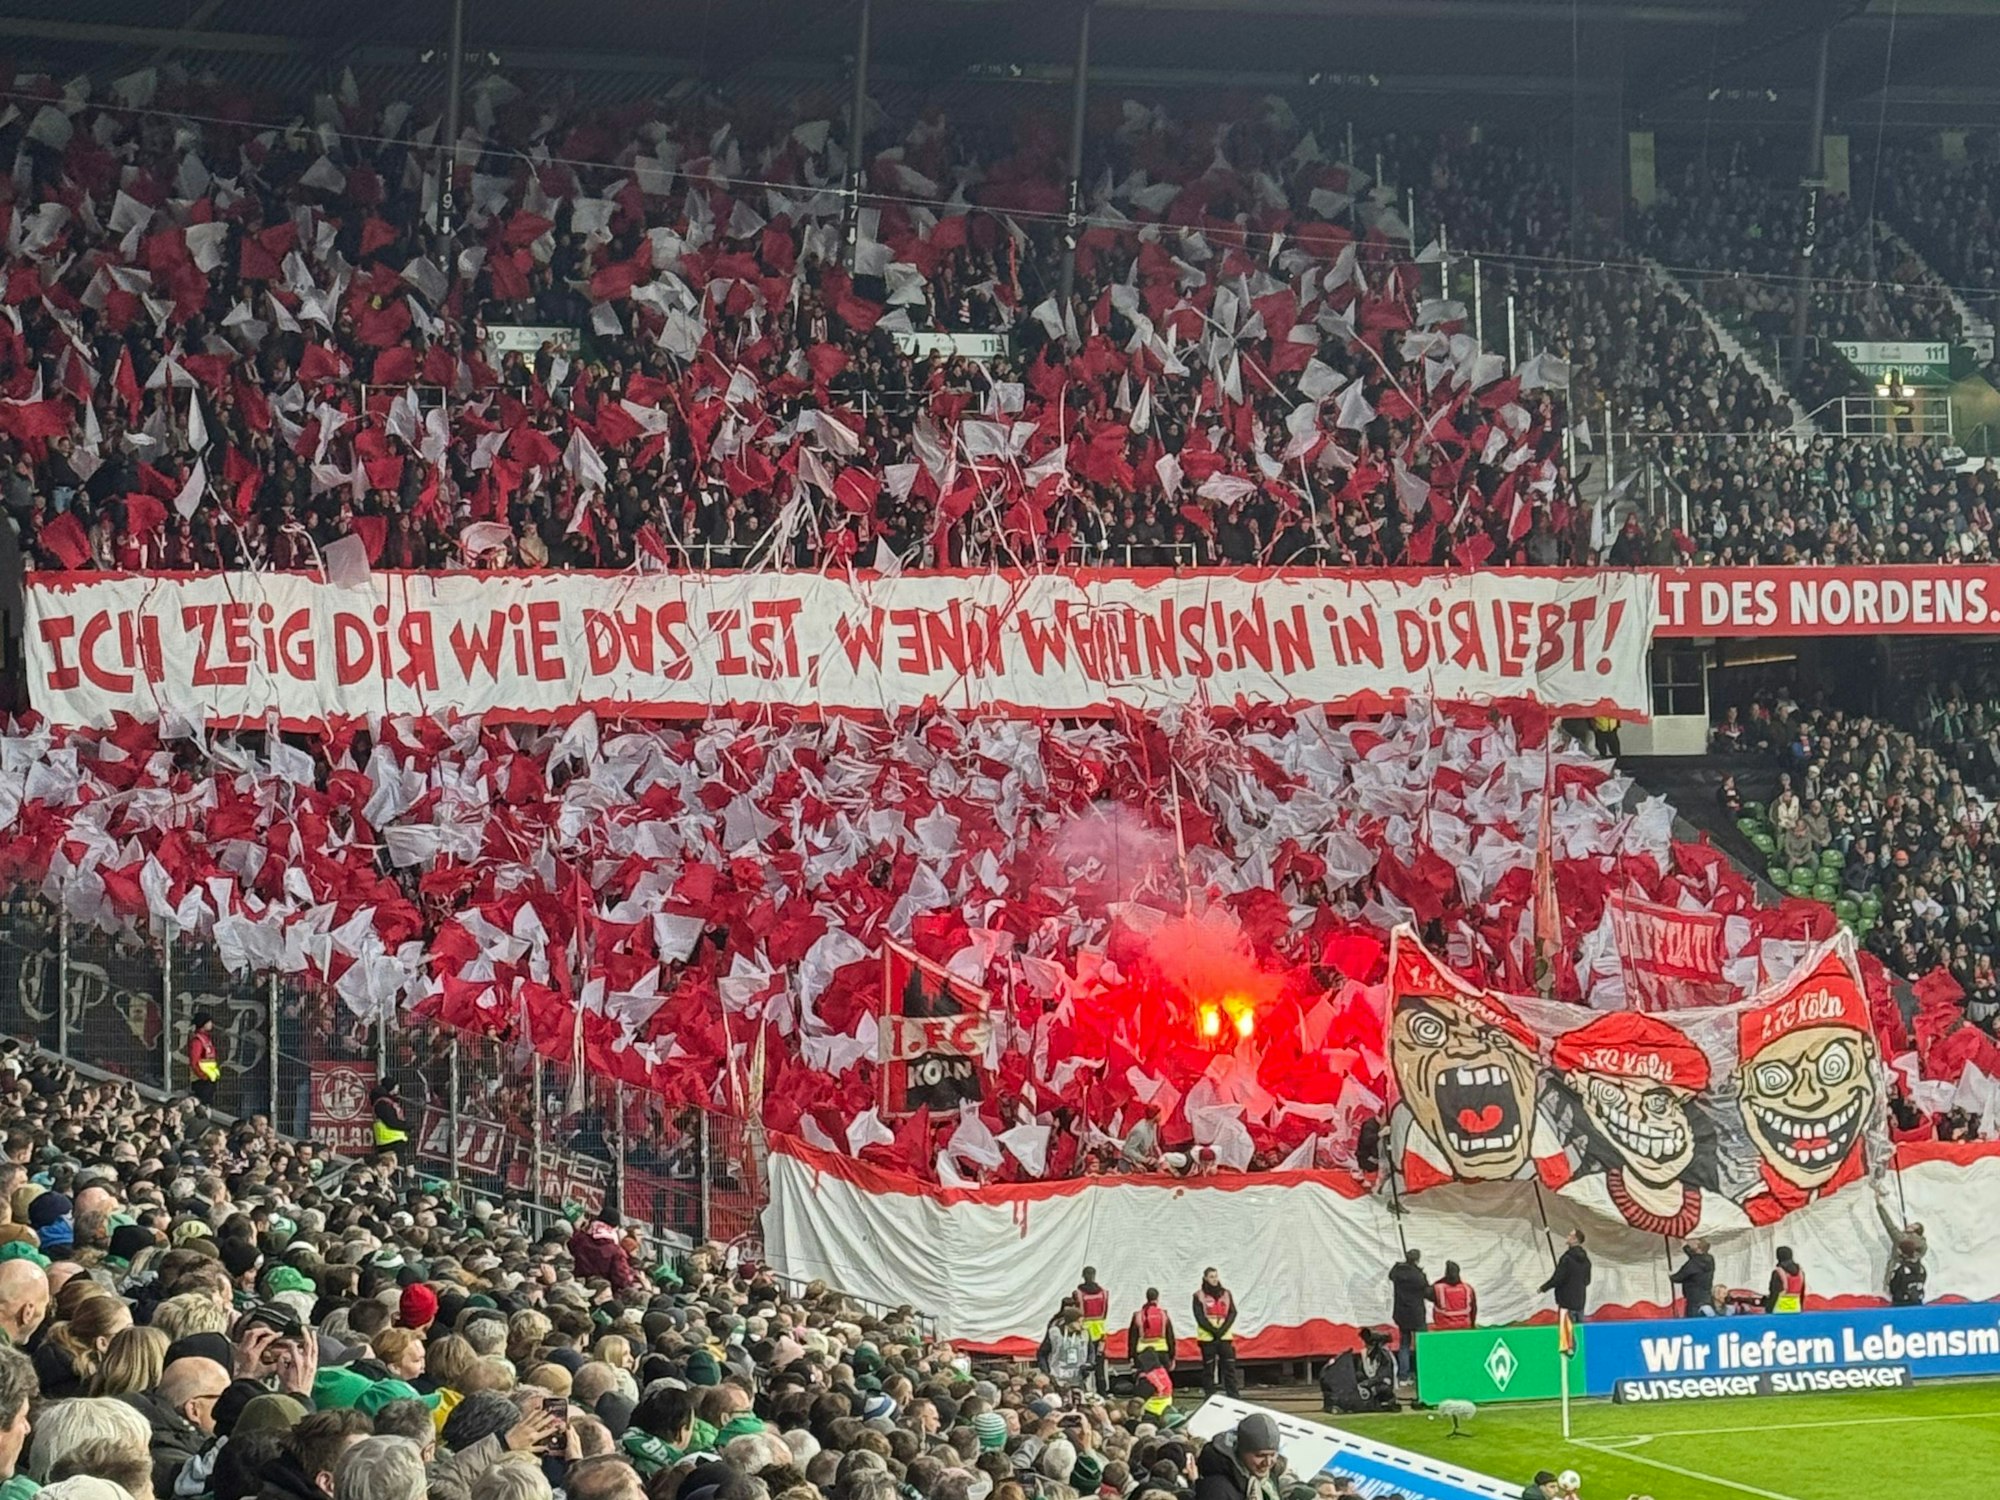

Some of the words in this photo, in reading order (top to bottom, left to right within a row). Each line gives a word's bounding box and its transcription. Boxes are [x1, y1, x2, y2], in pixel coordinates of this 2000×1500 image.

[443, 159, 453, 209] 119
[849, 172, 859, 219] 117
[1067, 180, 1077, 227] 115
[1806, 191, 1817, 235] 113
[1925, 346, 1946, 360] 111
[1700, 580, 1779, 626] DES
[39, 610, 164, 693] ICH
[582, 600, 694, 681] DAS
[835, 598, 1005, 680] WENN
[1797, 987, 1846, 1023] Köln
[1623, 1052, 1676, 1082] Köln
[1640, 1335, 1711, 1373] Wir
[1718, 1331, 1835, 1370] liefern
[1842, 1324, 2000, 1364] Lebensm
[1623, 1373, 1761, 1402] sunseeker
[1770, 1365, 1907, 1394] sunseeker
